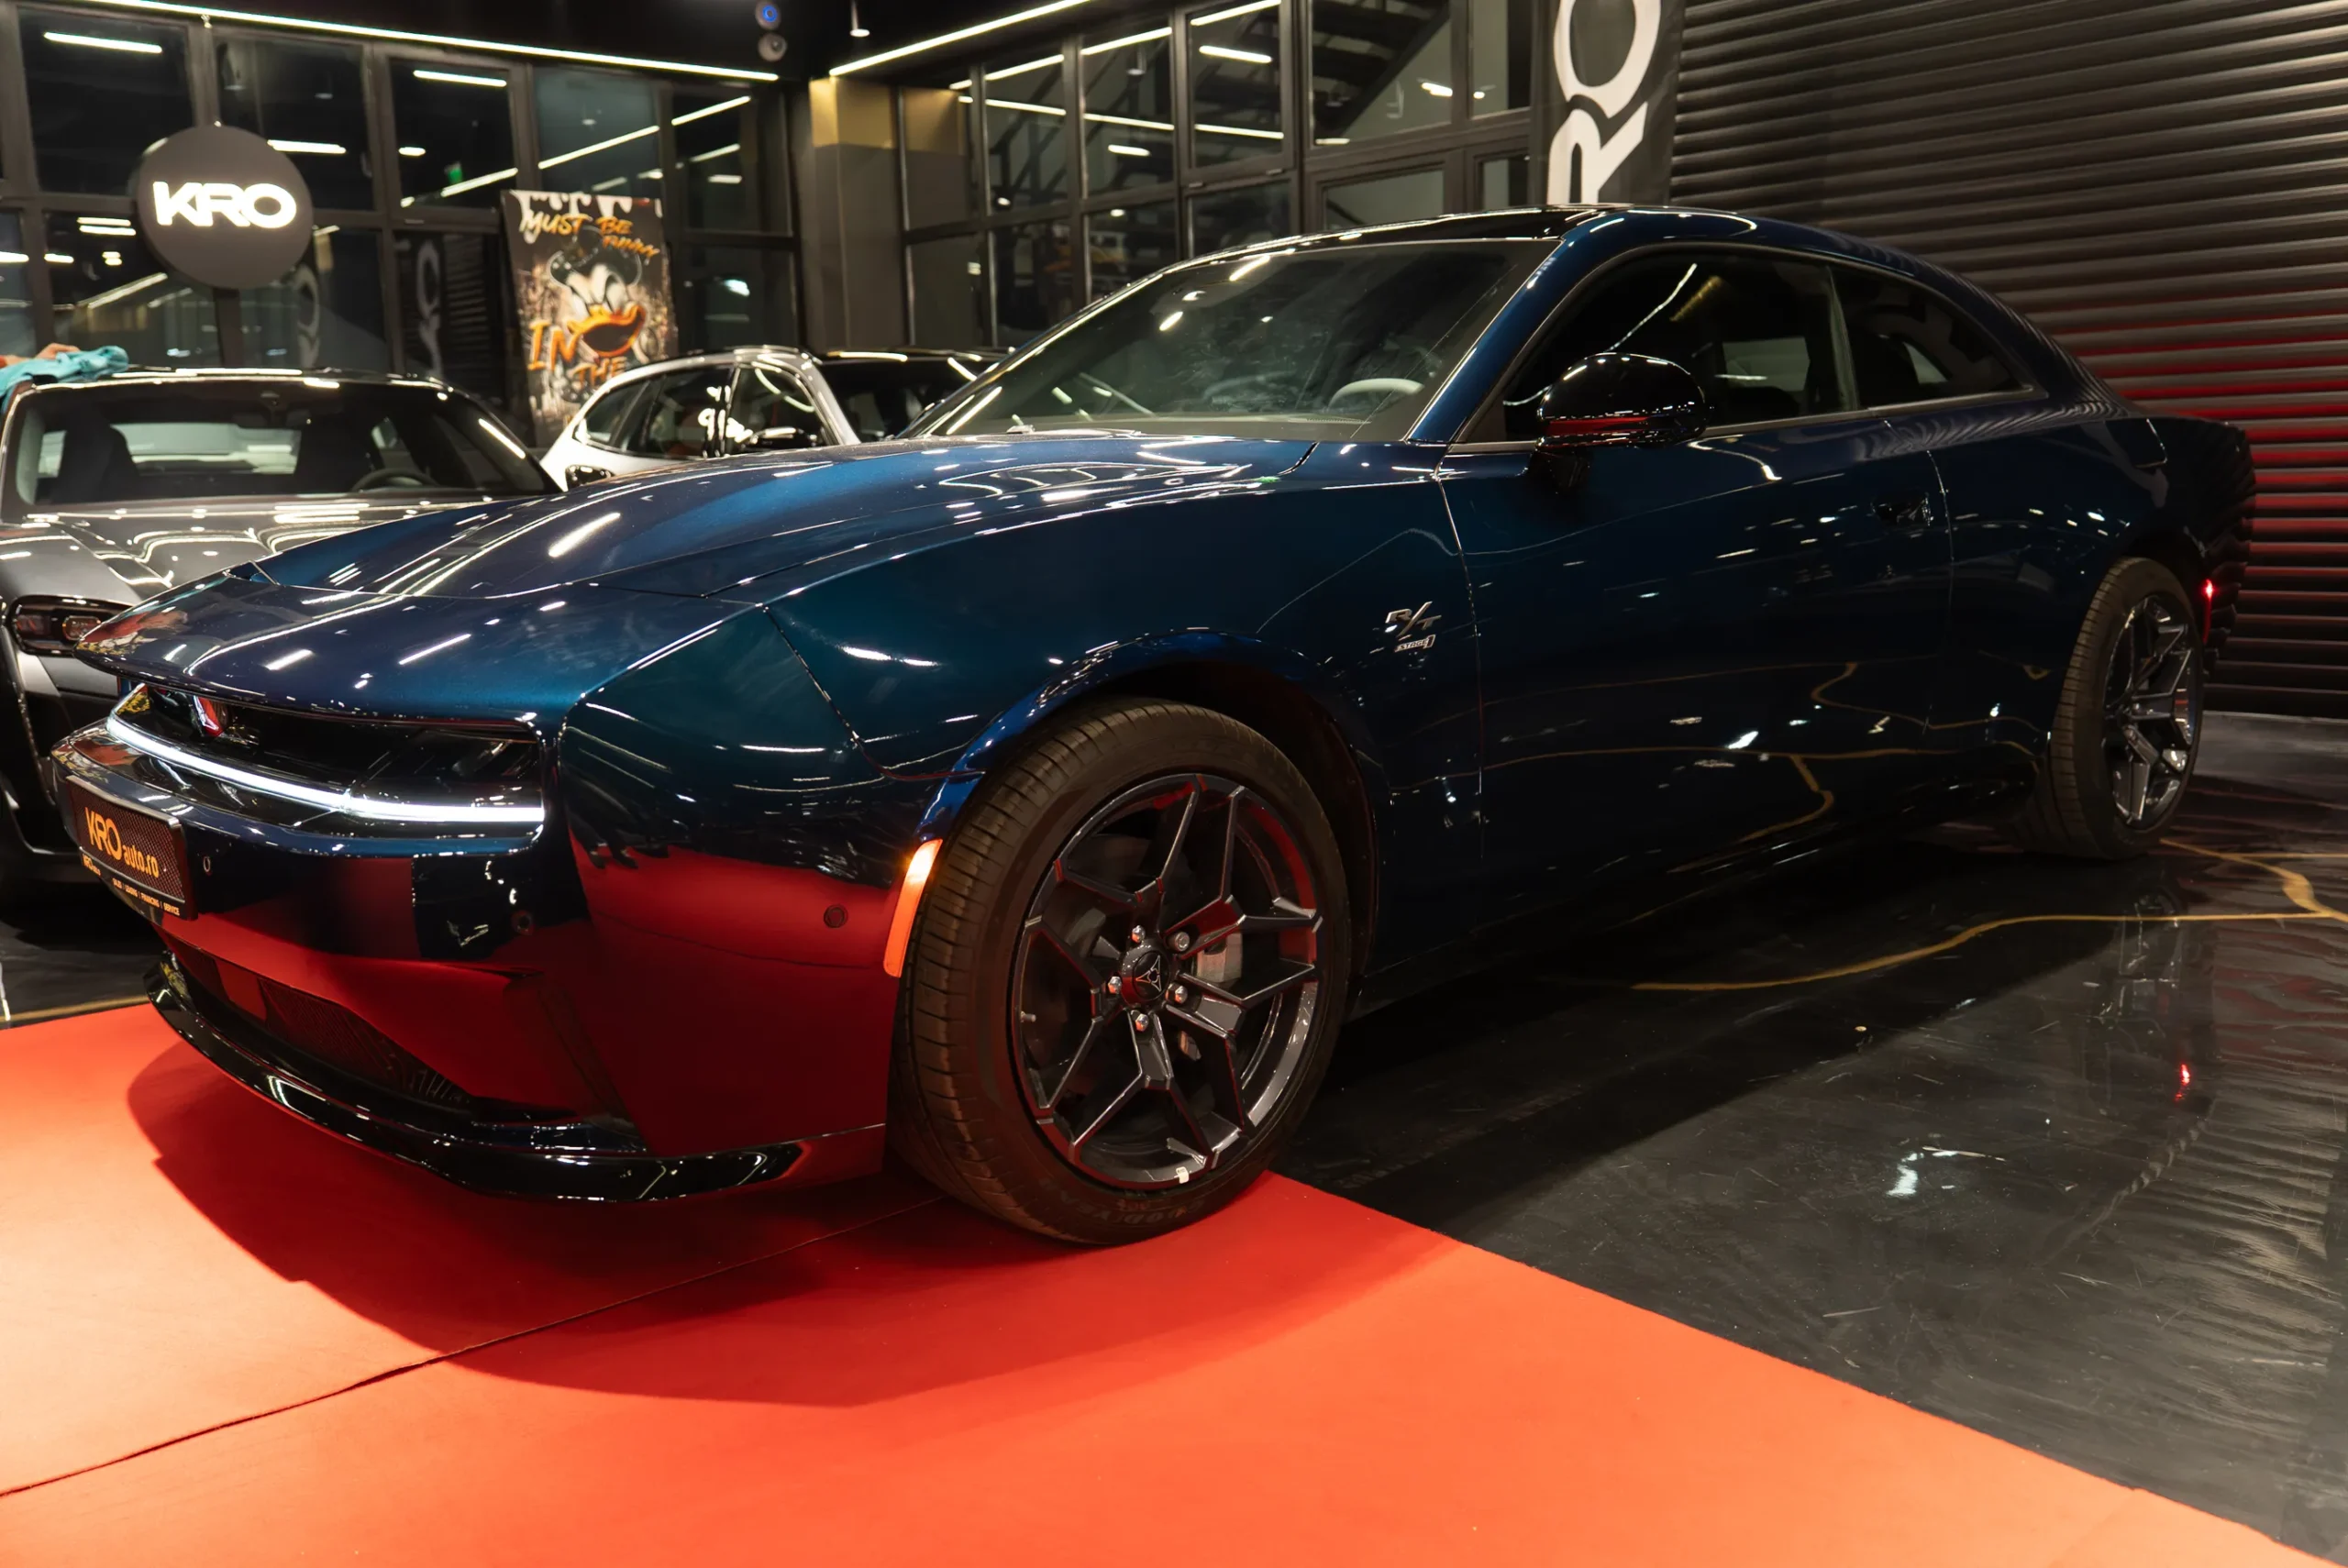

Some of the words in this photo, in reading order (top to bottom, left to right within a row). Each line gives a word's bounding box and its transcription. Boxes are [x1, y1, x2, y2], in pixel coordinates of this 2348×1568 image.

[152, 181, 297, 228] KRO
[519, 210, 593, 237] MUST
[595, 215, 634, 236] BE
[527, 319, 581, 372] IN
